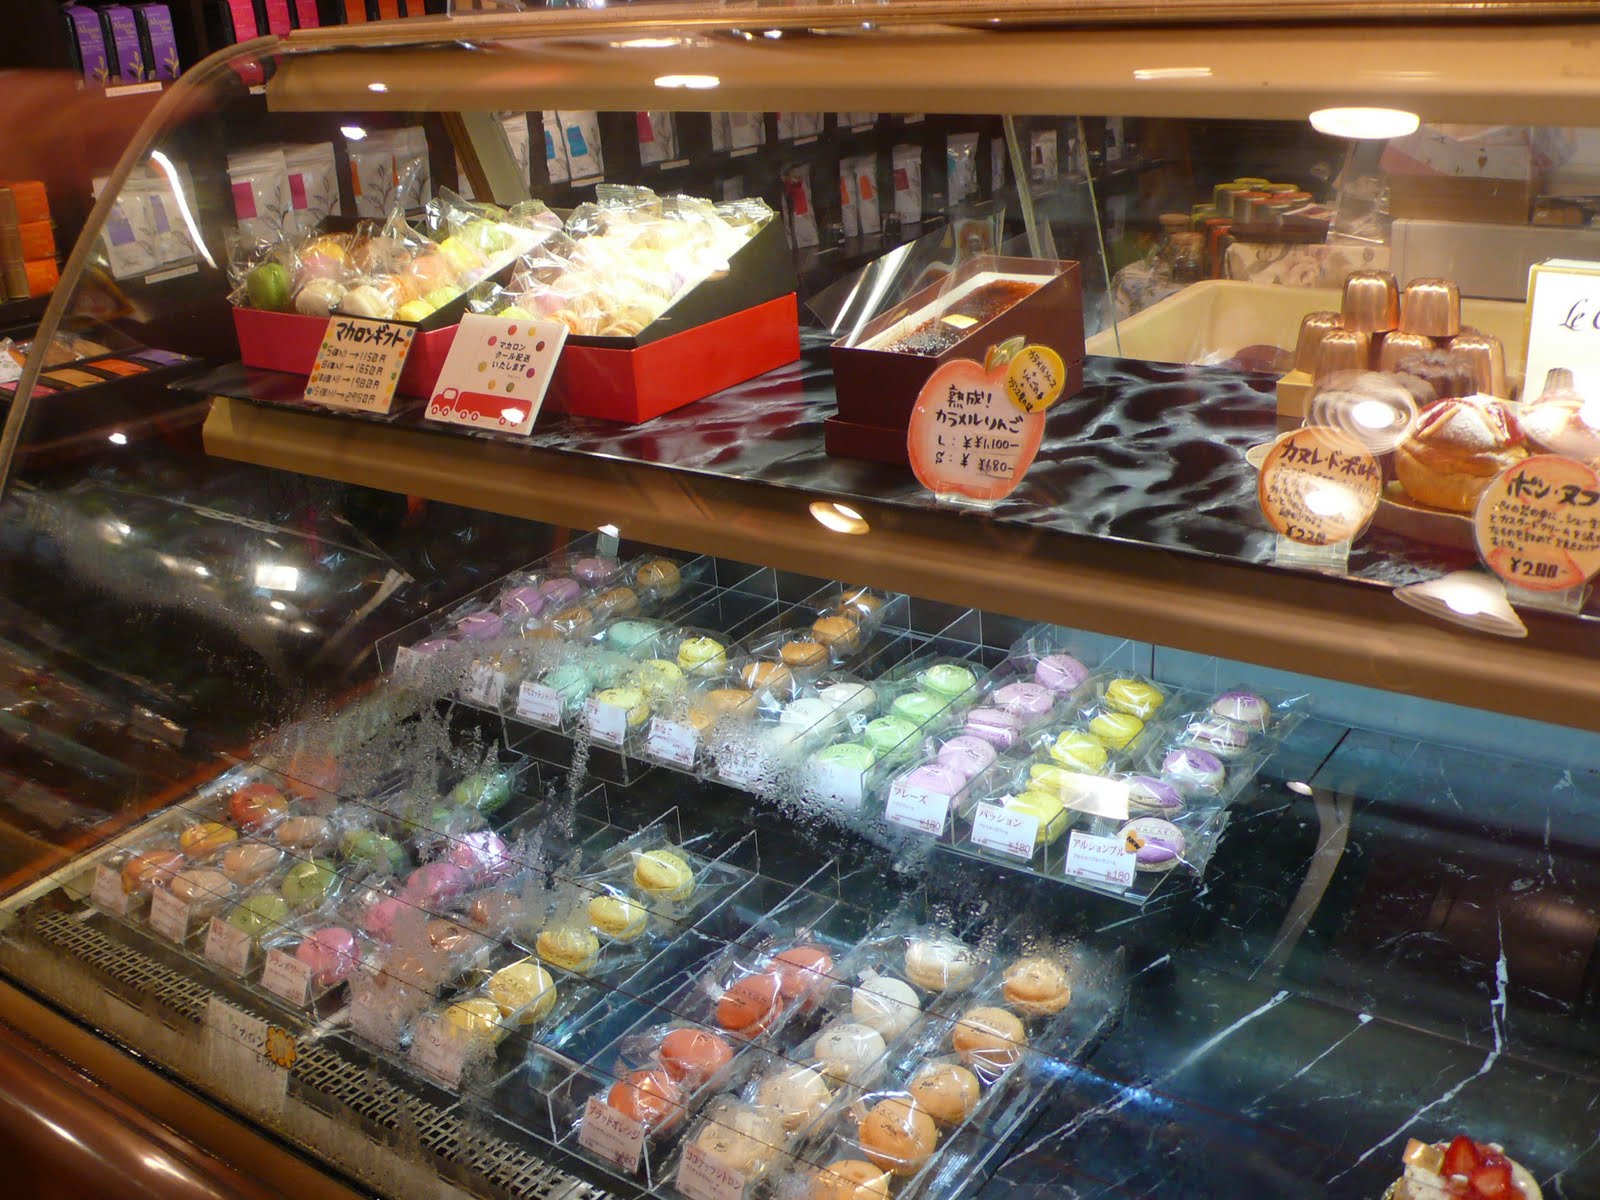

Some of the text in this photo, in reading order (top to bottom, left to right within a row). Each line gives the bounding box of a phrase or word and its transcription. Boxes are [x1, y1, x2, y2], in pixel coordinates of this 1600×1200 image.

[1558, 299, 1588, 331] Le
[336, 320, 405, 347] マカロンギフト
[499, 341, 526, 351] マカロン
[495, 351, 531, 363] クール配送
[491, 361, 527, 372] いたします
[936, 409, 1024, 433] カラメルりんご
[895, 787, 928, 804] フレーズ
[920, 818, 941, 831] ¥180
[979, 810, 1022, 827] パッション
[1008, 841, 1031, 854] ¥180
[1106, 870, 1131, 882] ¥180
